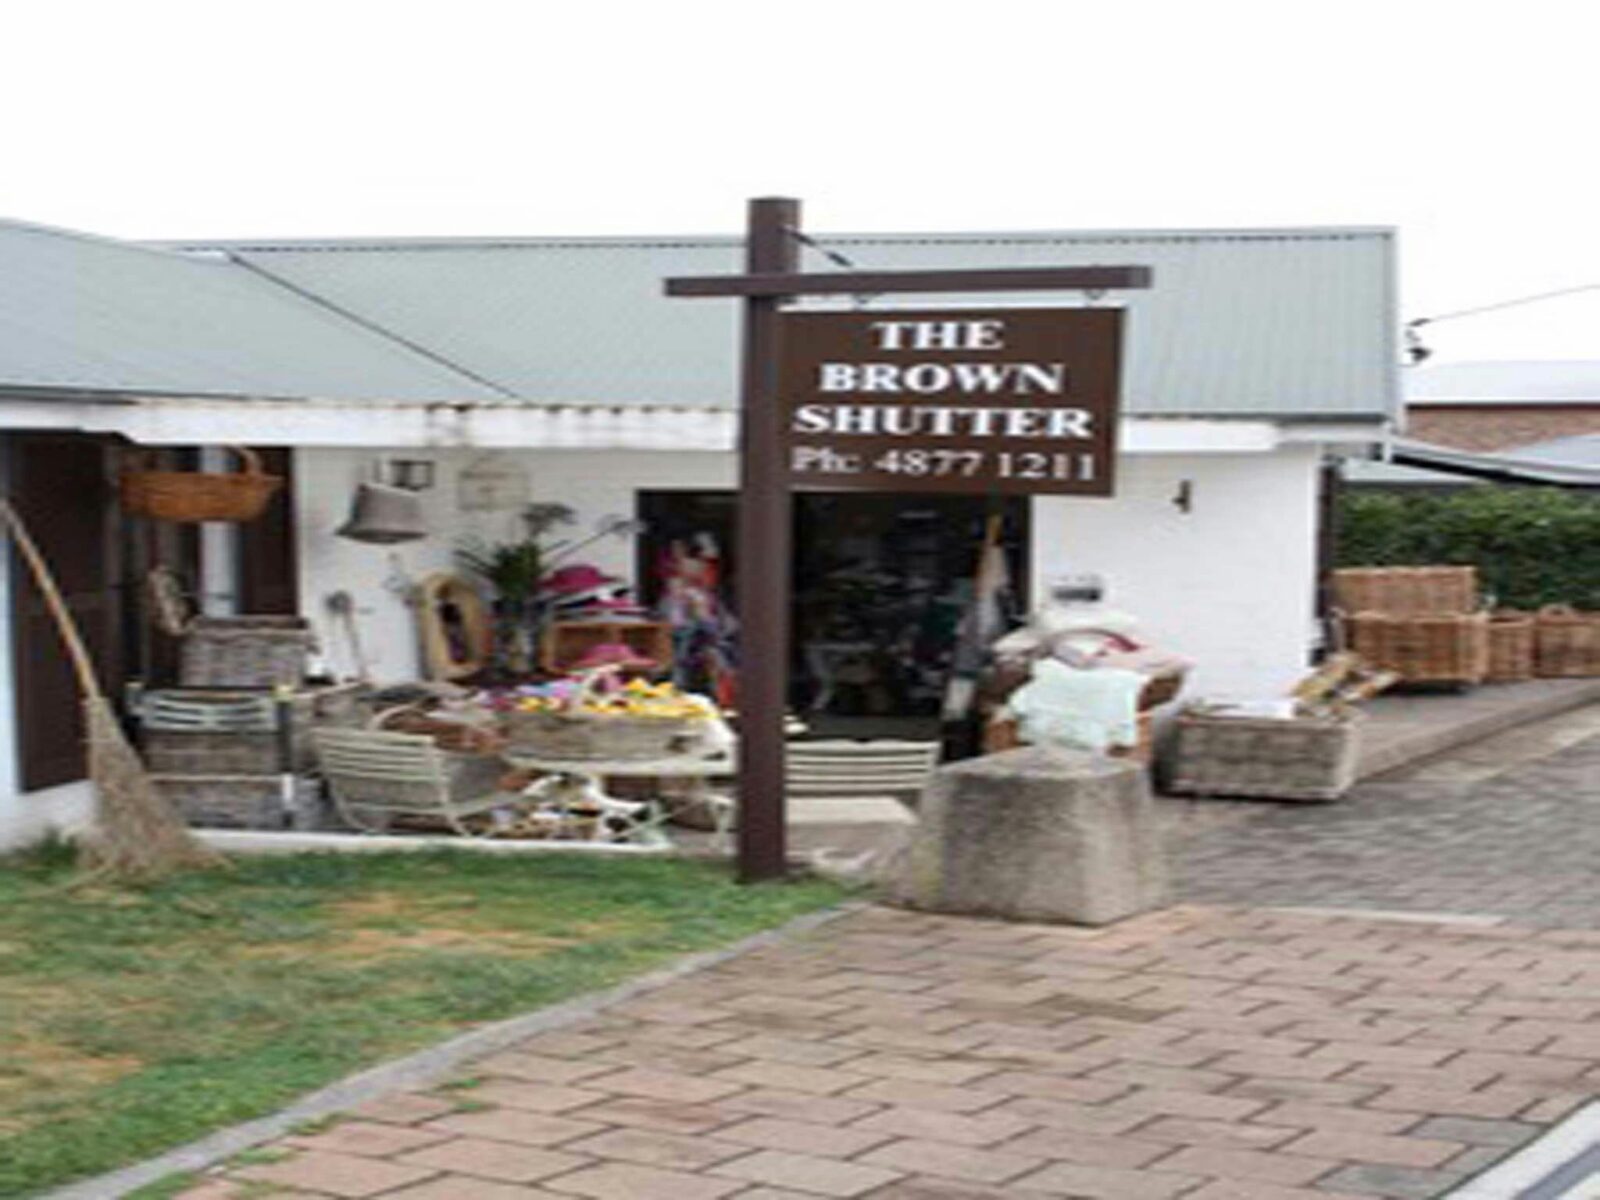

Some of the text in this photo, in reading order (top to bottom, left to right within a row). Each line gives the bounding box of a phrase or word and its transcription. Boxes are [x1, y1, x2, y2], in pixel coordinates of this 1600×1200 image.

[872, 320, 1004, 350] THE
[819, 363, 1066, 393] BROWN
[792, 404, 1094, 438] SHUTTER
[790, 446, 1096, 481] Ph: 4877 1211
